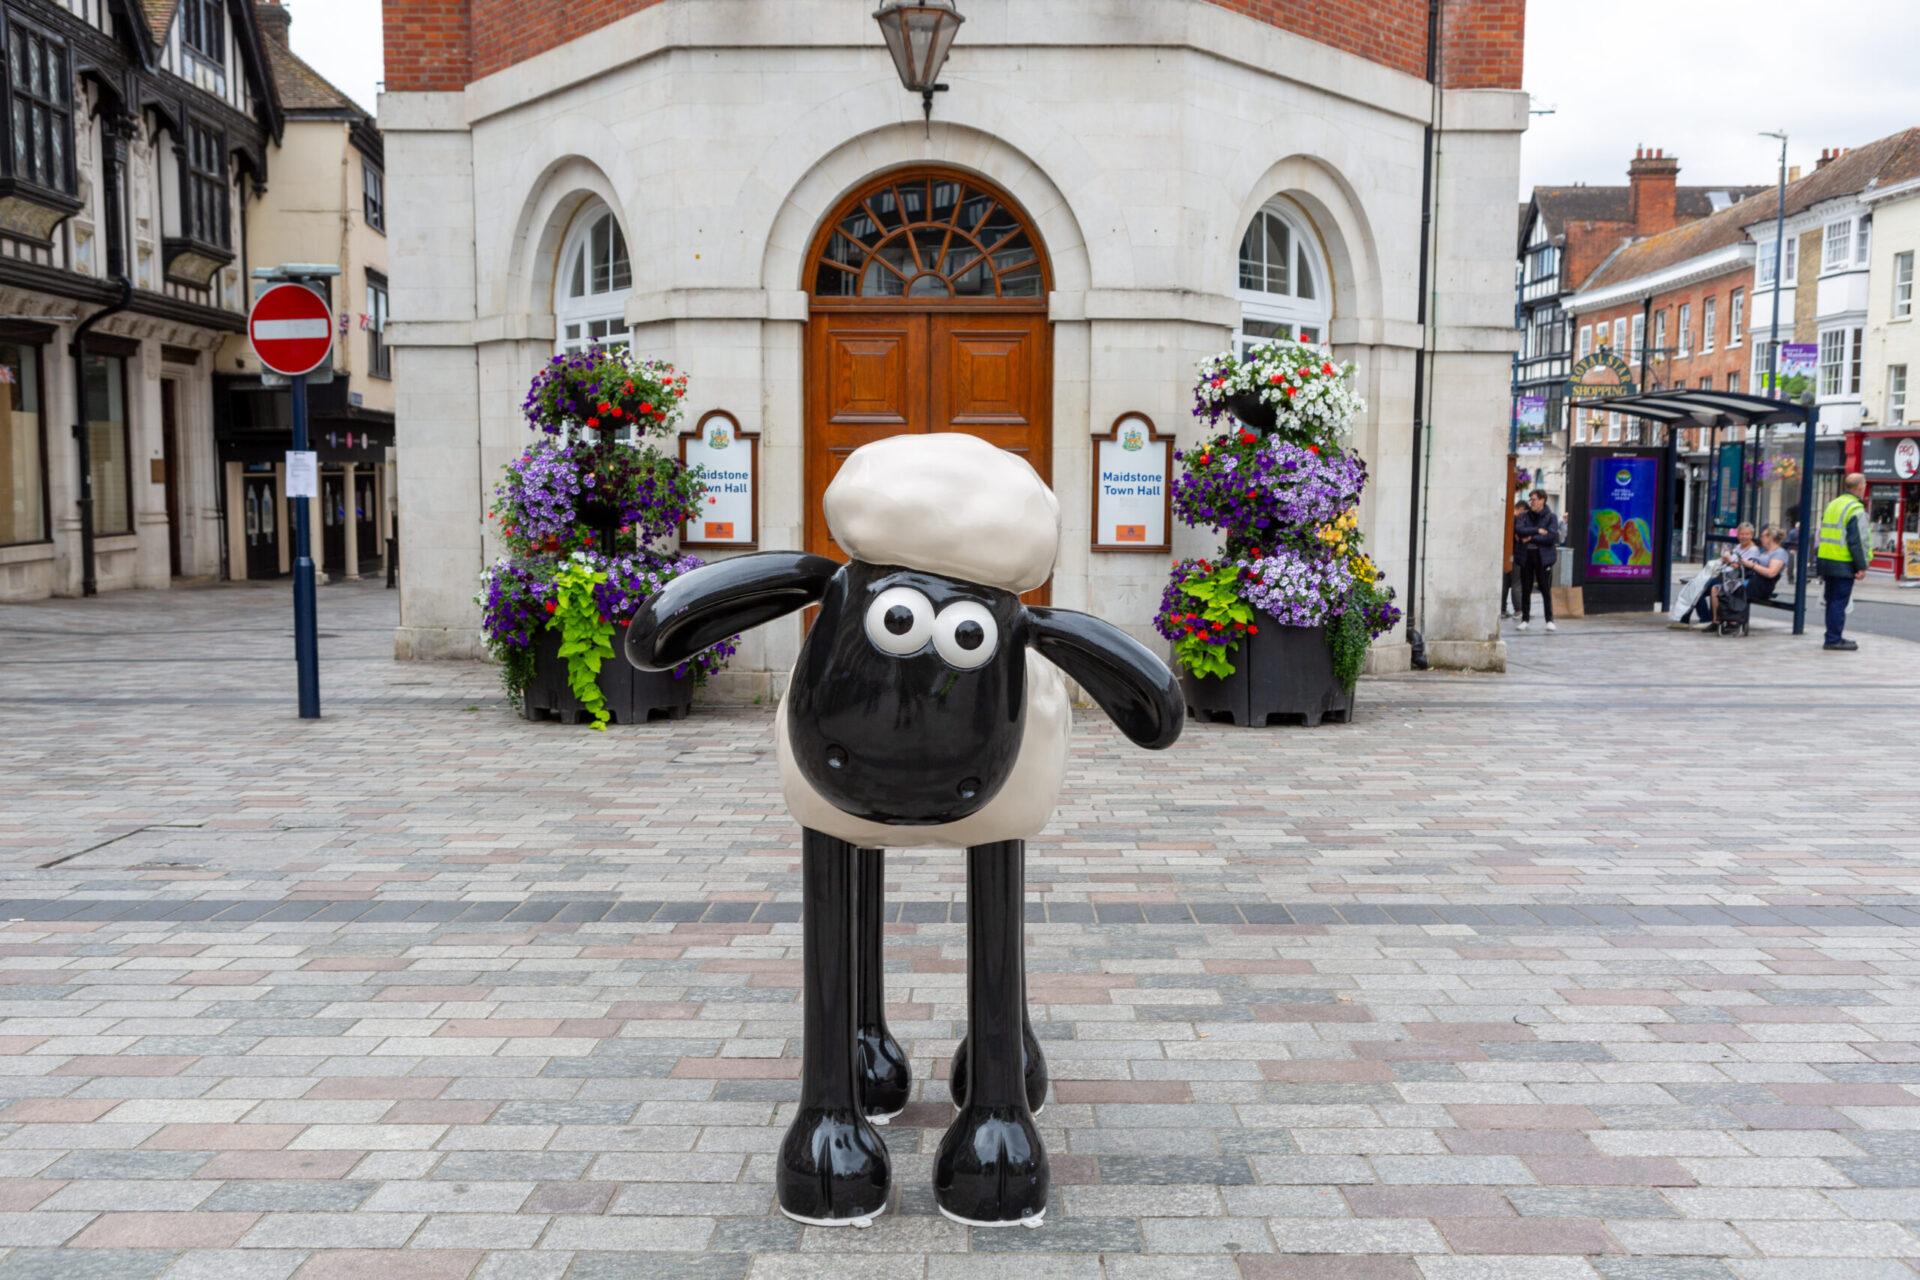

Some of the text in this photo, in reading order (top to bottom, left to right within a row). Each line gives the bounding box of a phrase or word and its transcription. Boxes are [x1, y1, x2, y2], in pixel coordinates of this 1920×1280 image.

[1569, 353, 1631, 383] ROYAL STAR
[1572, 385, 1628, 396] SHOPPING
[1103, 472, 1162, 482] Maidstone
[725, 483, 747, 493] Hall
[1104, 485, 1160, 496] Town Hall
